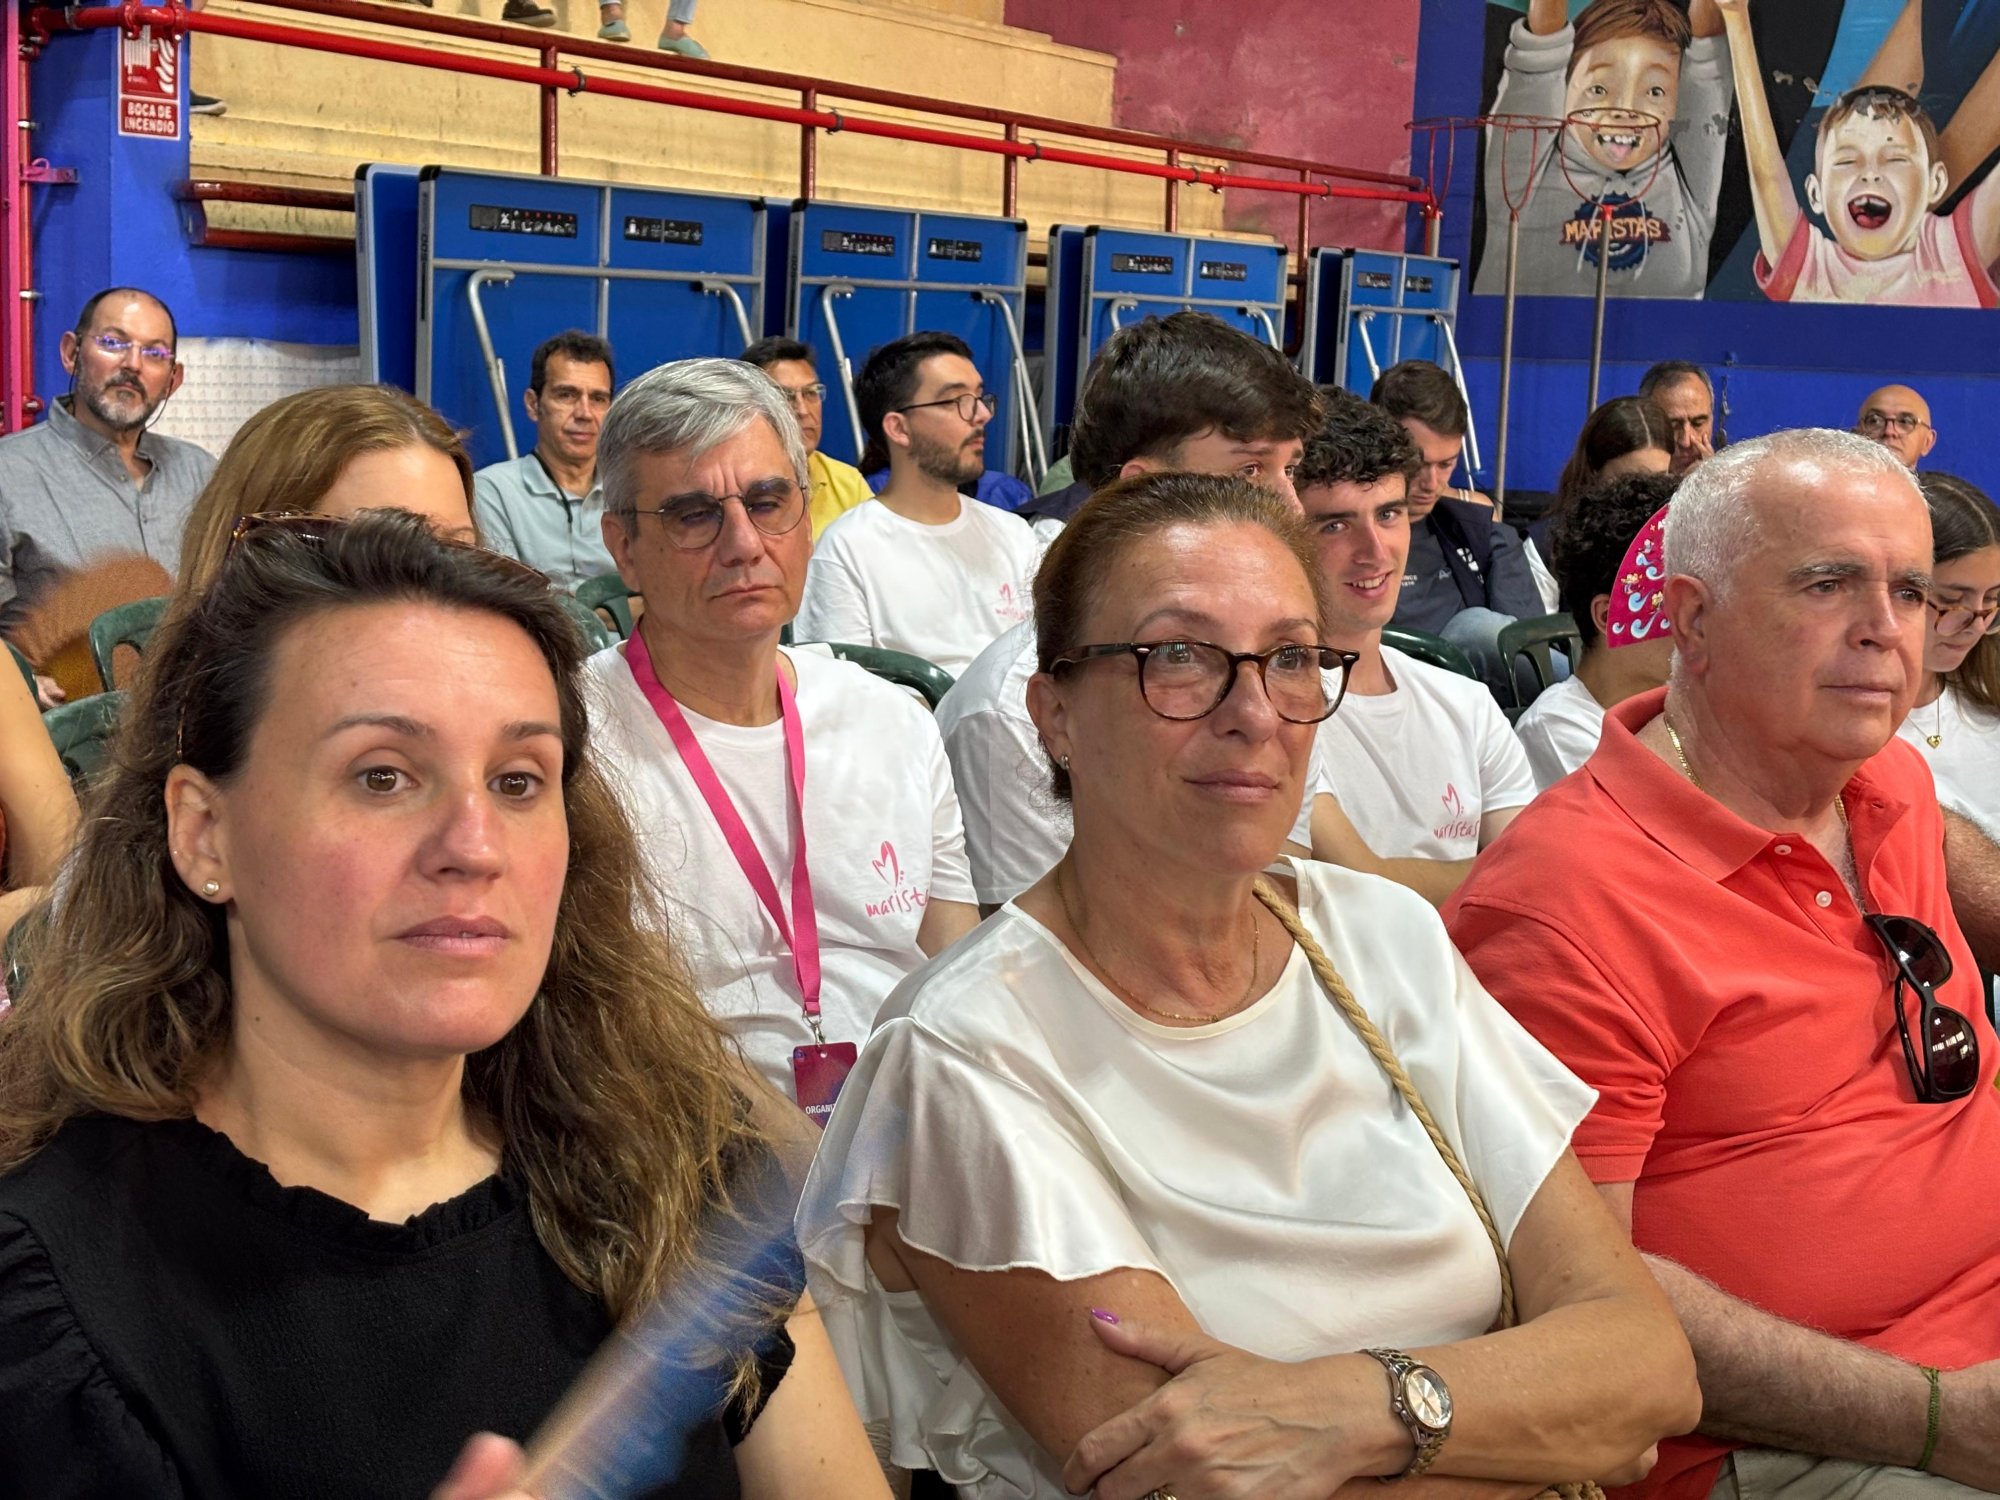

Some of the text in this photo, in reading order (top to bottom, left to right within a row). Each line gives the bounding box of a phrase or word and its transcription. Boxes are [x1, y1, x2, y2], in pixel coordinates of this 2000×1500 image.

[127, 101, 172, 119] BOCA DE
[124, 116, 175, 134] INCENDIO
[1565, 216, 1662, 242] MARSTAS
